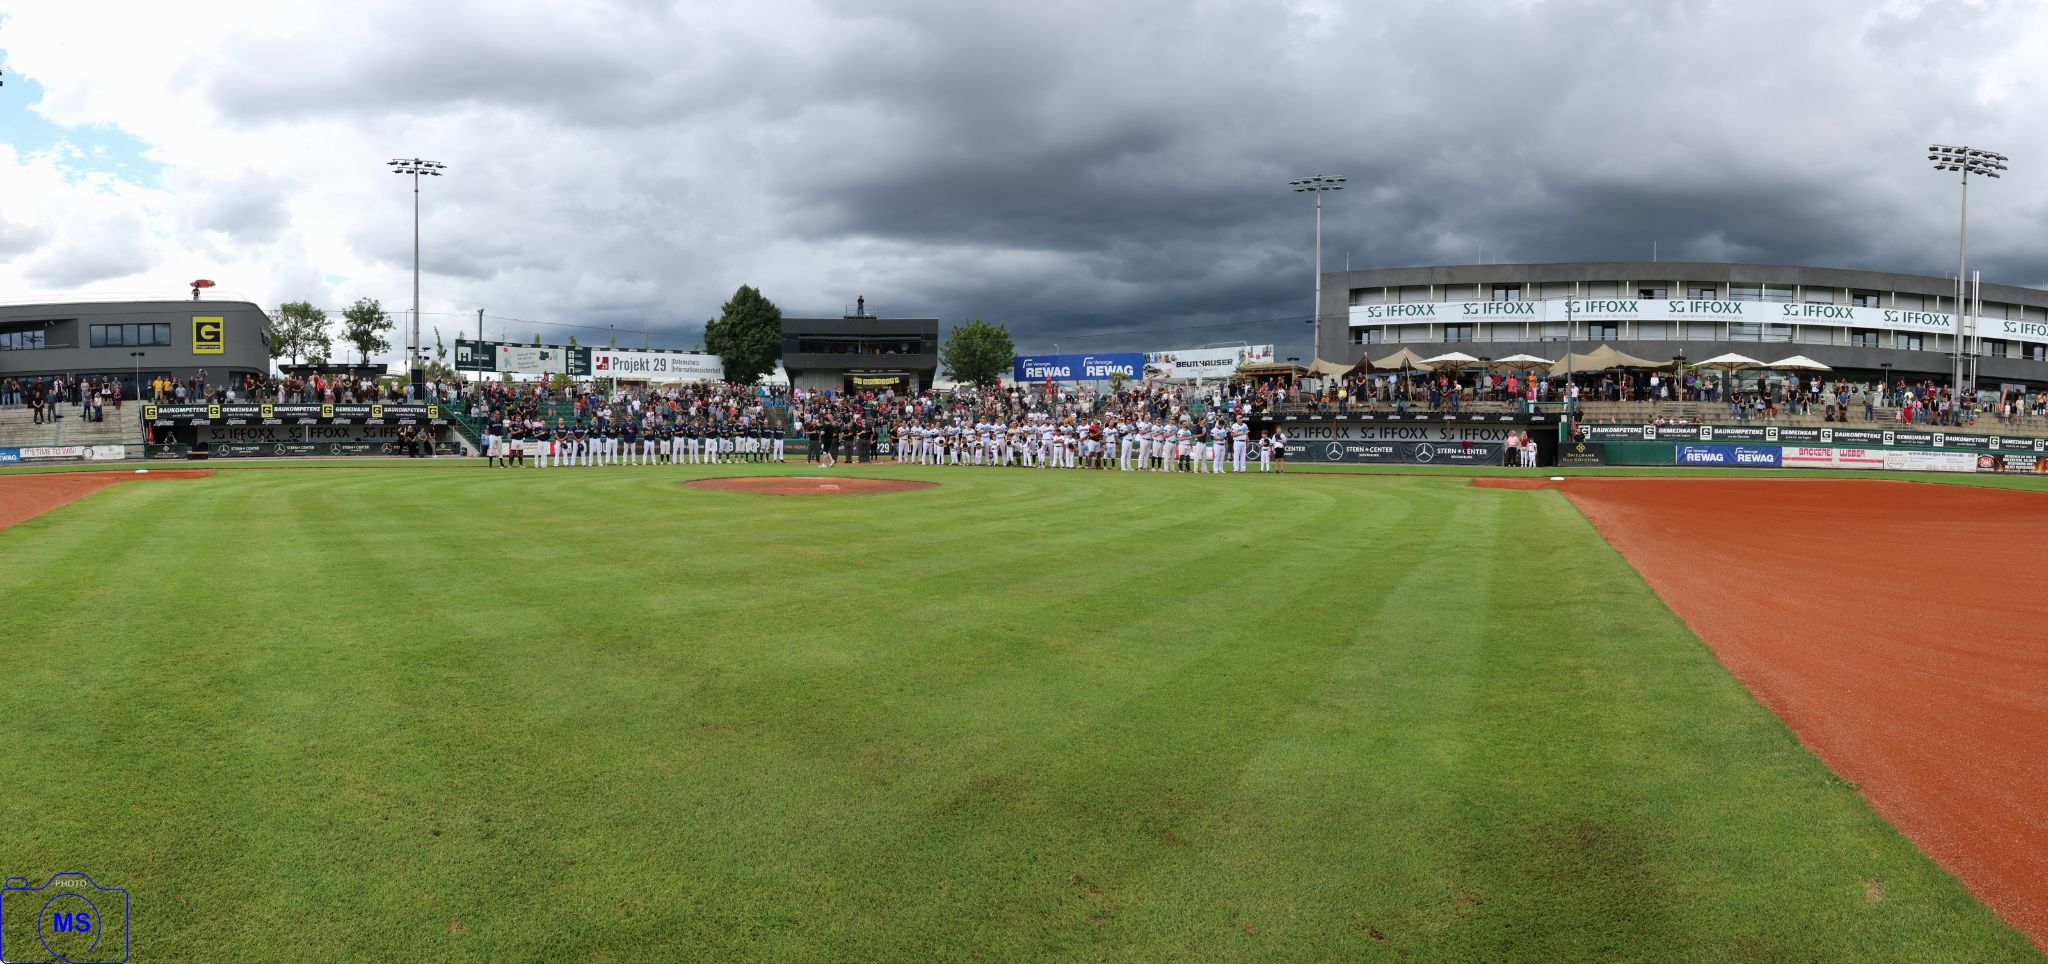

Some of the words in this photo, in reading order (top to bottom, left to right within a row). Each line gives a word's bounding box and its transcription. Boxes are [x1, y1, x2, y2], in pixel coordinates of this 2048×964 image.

[1387, 304, 1435, 316] IFFOXX
[1484, 302, 1534, 314] IFFOXX
[1586, 301, 1638, 312] IFFOXX
[1690, 301, 1742, 313] IFFOXX
[1804, 305, 1853, 319] IFFOXX
[1904, 312, 1950, 326] IFFOXX
[612, 357, 650, 373] Projekt
[654, 358, 666, 372] 29
[1086, 365, 1134, 376] REWAG
[1026, 366, 1070, 378] REWAG
[230, 428, 275, 438] IFFOXX
[1380, 428, 1428, 440] IFFOXX
[1687, 454, 1724, 462] REWAG
[1738, 454, 1774, 462] REWAG
[1840, 449, 1864, 457] WEBER
